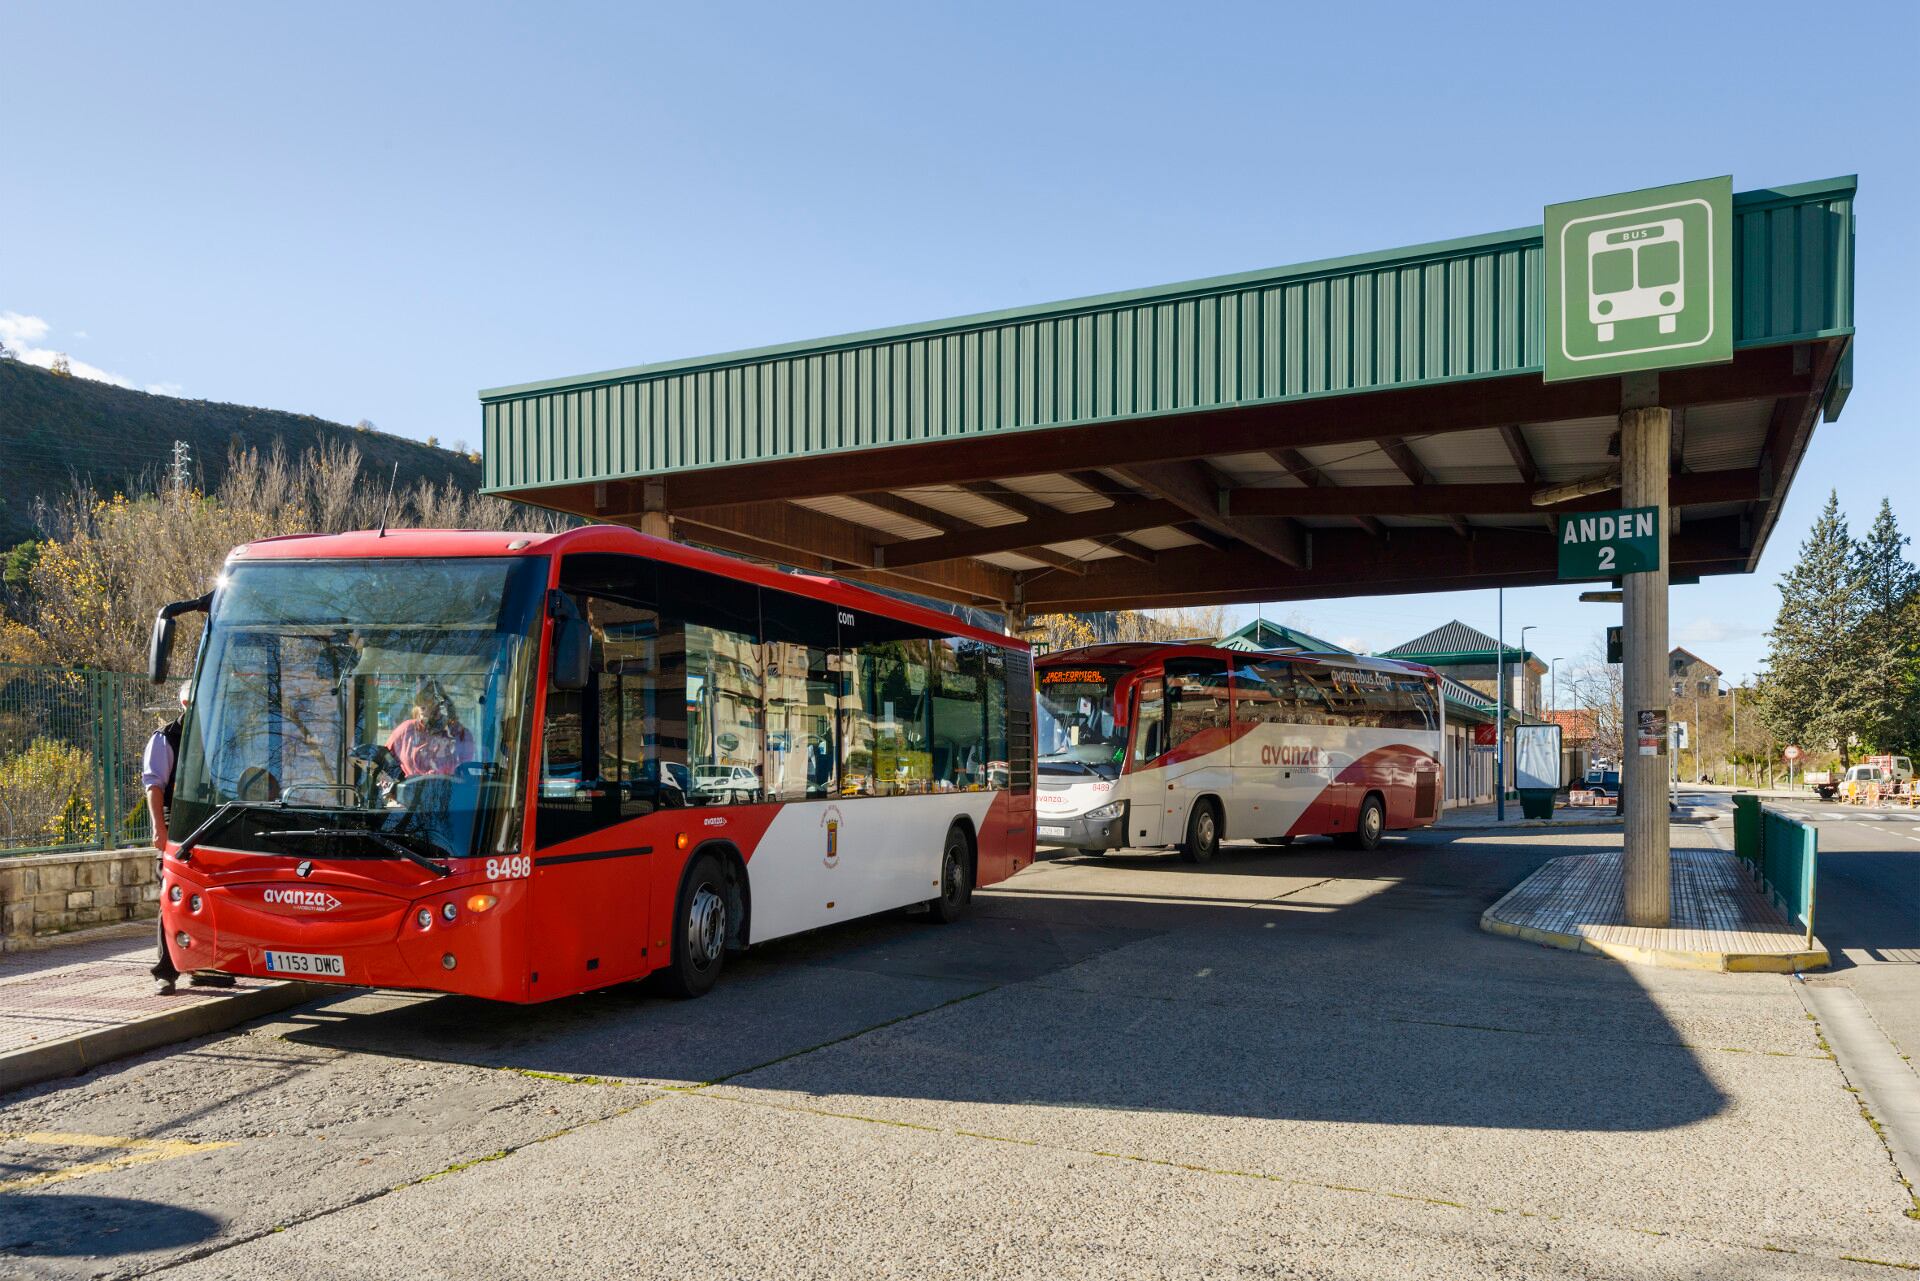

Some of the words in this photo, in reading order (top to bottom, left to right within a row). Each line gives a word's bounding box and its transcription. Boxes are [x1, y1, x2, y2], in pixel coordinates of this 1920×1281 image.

[1623, 230, 1648, 240] BUS
[1563, 512, 1653, 545] ANDEN
[1598, 546, 1616, 570] 2
[1261, 744, 1318, 765] avanza
[486, 855, 531, 880] 8498
[263, 889, 325, 906] avanza
[278, 954, 309, 971] 1153
[314, 957, 341, 974] DWC
